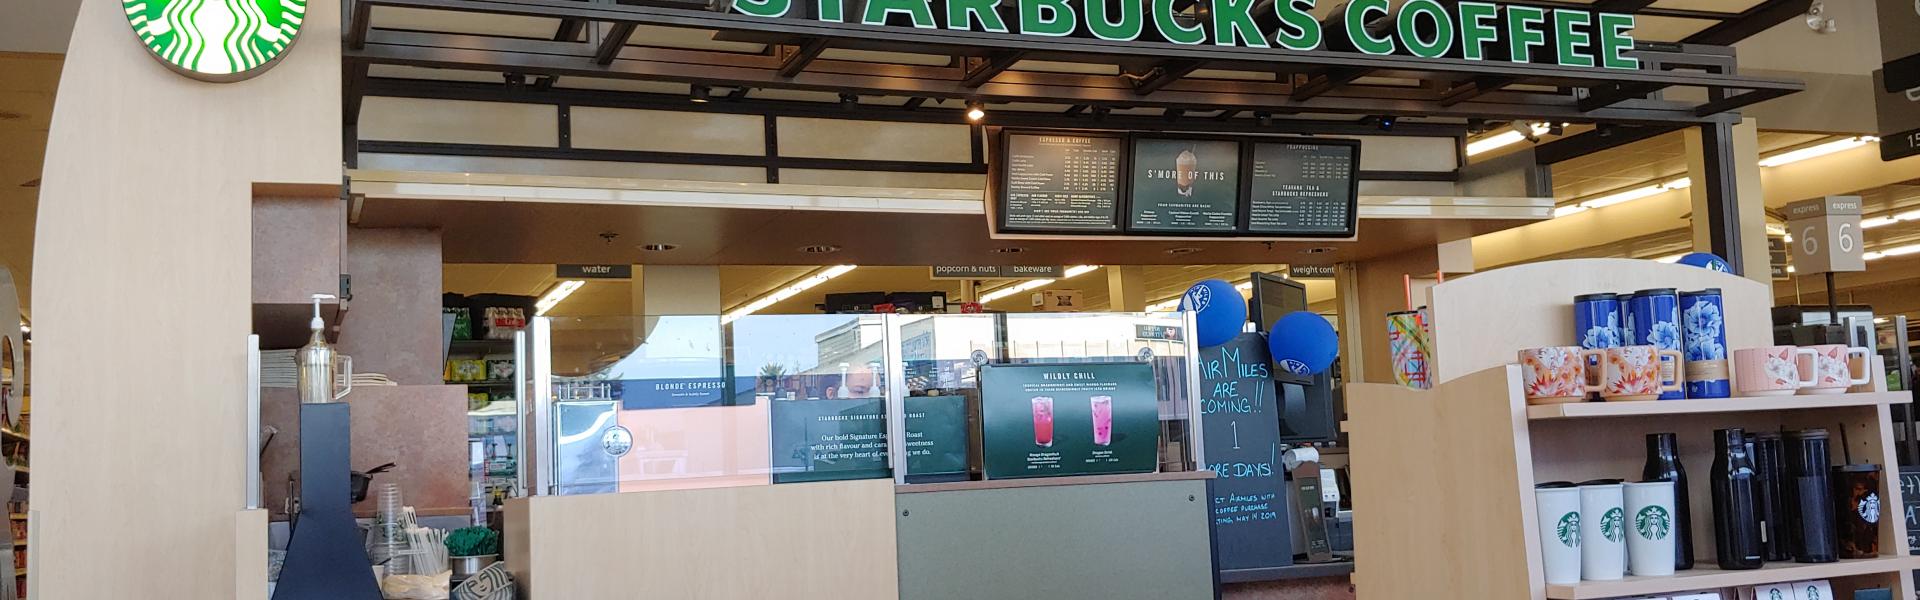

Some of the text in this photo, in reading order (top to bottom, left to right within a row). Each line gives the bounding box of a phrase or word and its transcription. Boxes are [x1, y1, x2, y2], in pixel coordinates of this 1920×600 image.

[732, 0, 1639, 69] ARBUCKS COFFEE
[1147, 169, 1225, 181] S'MORE OF THIS
[1792, 201, 1858, 215] express express
[1802, 222, 1854, 256] 6 6
[581, 265, 612, 274] water
[936, 265, 970, 275] popcorn
[978, 265, 997, 274] nuts
[1013, 265, 1053, 274] bakeware
[1293, 265, 1318, 275] weight
[1222, 346, 1269, 379] MILES
[1042, 371, 1096, 381] WILDLY CHILL
[688, 381, 726, 390] ESPRESSO
[1212, 381, 1239, 398] ARE
[849, 431, 878, 442] Signature
[1230, 420, 1241, 450] 1
[839, 451, 854, 460] very
[1260, 511, 1277, 520] 2019
